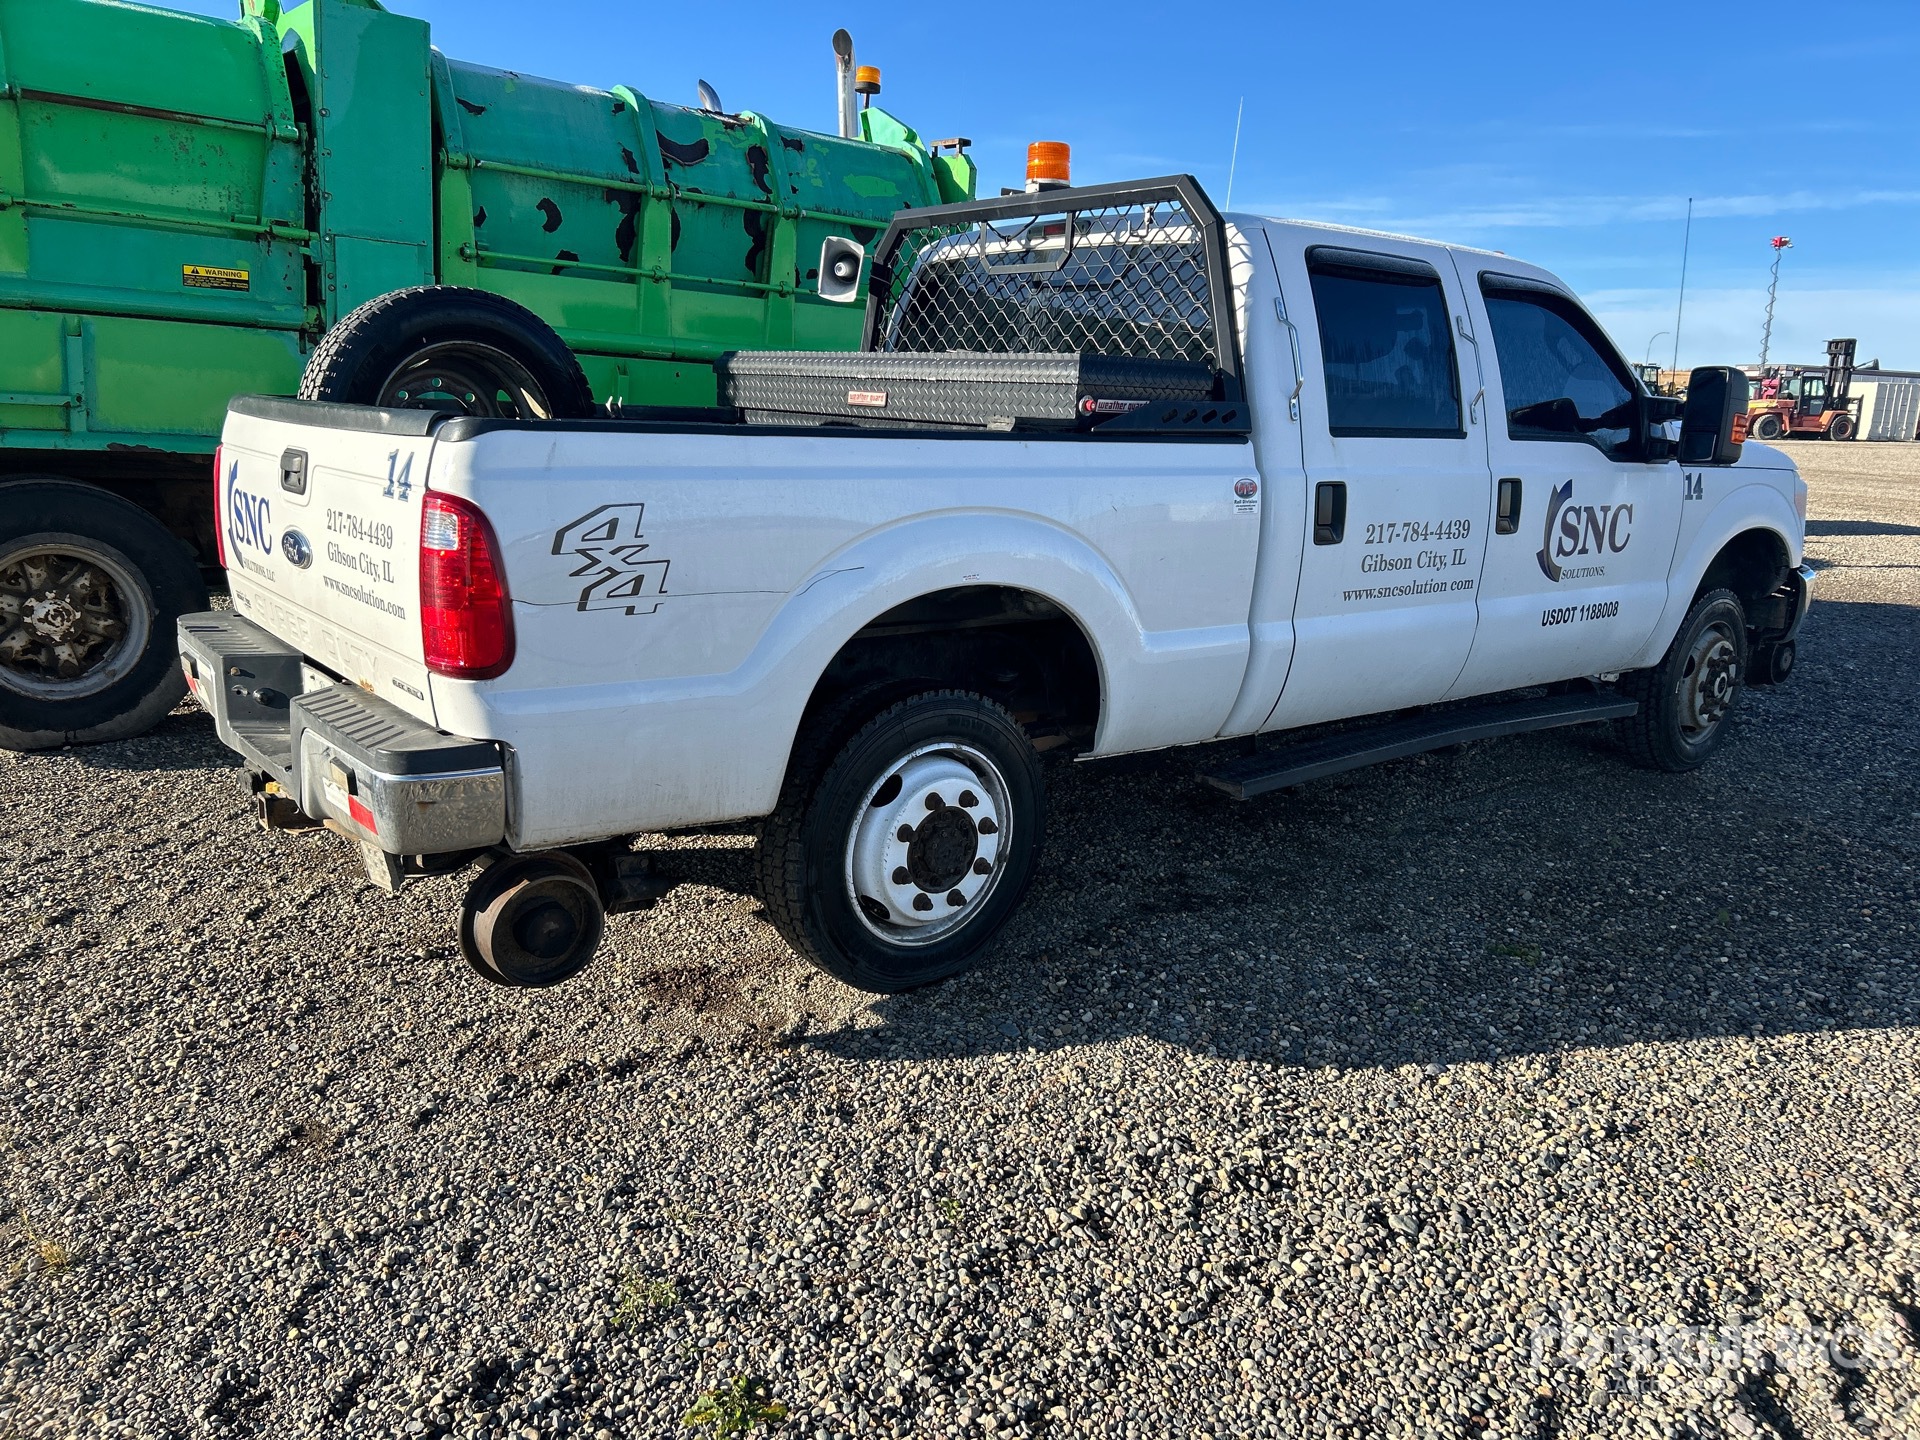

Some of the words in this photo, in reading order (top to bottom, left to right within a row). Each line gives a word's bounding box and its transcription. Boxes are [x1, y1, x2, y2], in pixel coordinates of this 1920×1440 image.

[205, 268, 242, 278] WARNING
[1097, 401, 1126, 410] weather
[383, 449, 414, 502] 14
[1684, 472, 1703, 501] 14
[233, 488, 273, 556] SNC
[326, 508, 394, 550] 217-784-4439
[1364, 519, 1471, 545] 217-784-4439
[1555, 503, 1634, 558] SNC
[327, 541, 358, 571] Gibson
[359, 552, 381, 583] City,
[382, 559, 395, 584] IL
[1361, 553, 1412, 573] Gibson
[1416, 550, 1447, 571] City,
[1451, 548, 1467, 566] IL
[322, 575, 407, 621] www.sncsolution.com
[1541, 606, 1577, 627] USDOT
[1580, 600, 1619, 622] 1188008
[254, 593, 313, 649] SUPER
[321, 629, 378, 682] DUTY
